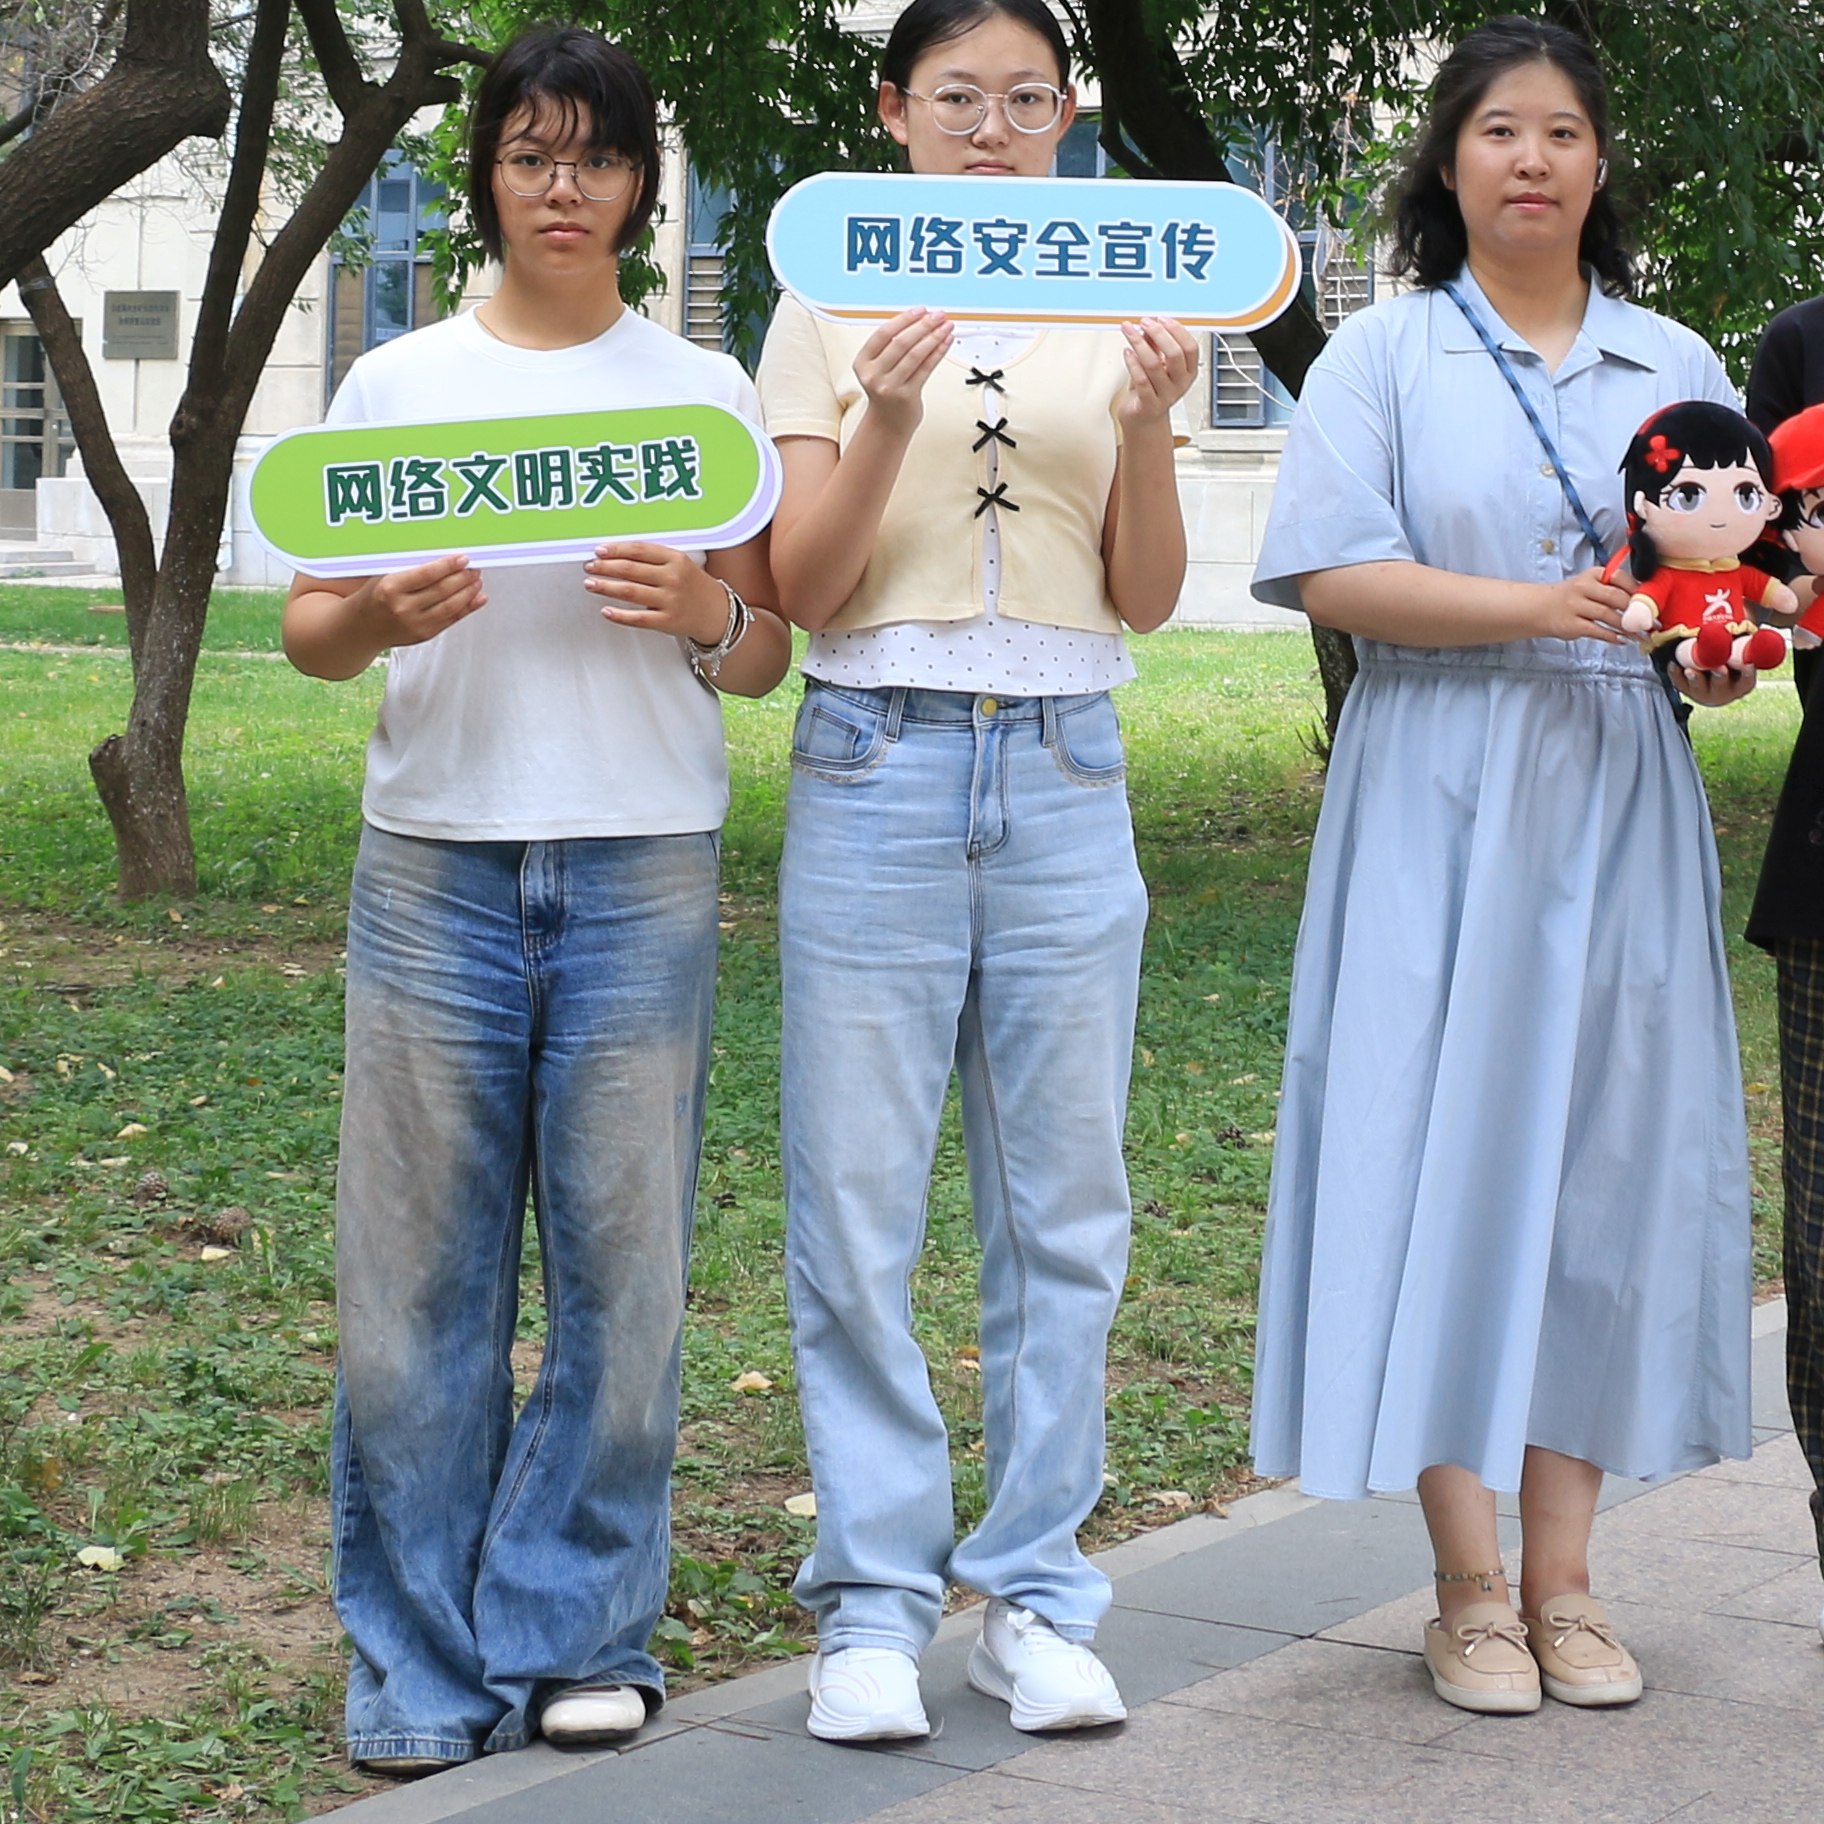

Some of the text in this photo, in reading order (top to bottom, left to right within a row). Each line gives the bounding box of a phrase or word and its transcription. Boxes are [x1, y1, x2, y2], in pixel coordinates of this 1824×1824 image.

[845, 214, 1215, 281] 网络安全宣传
[324, 438, 700, 522] 网络文明实践
